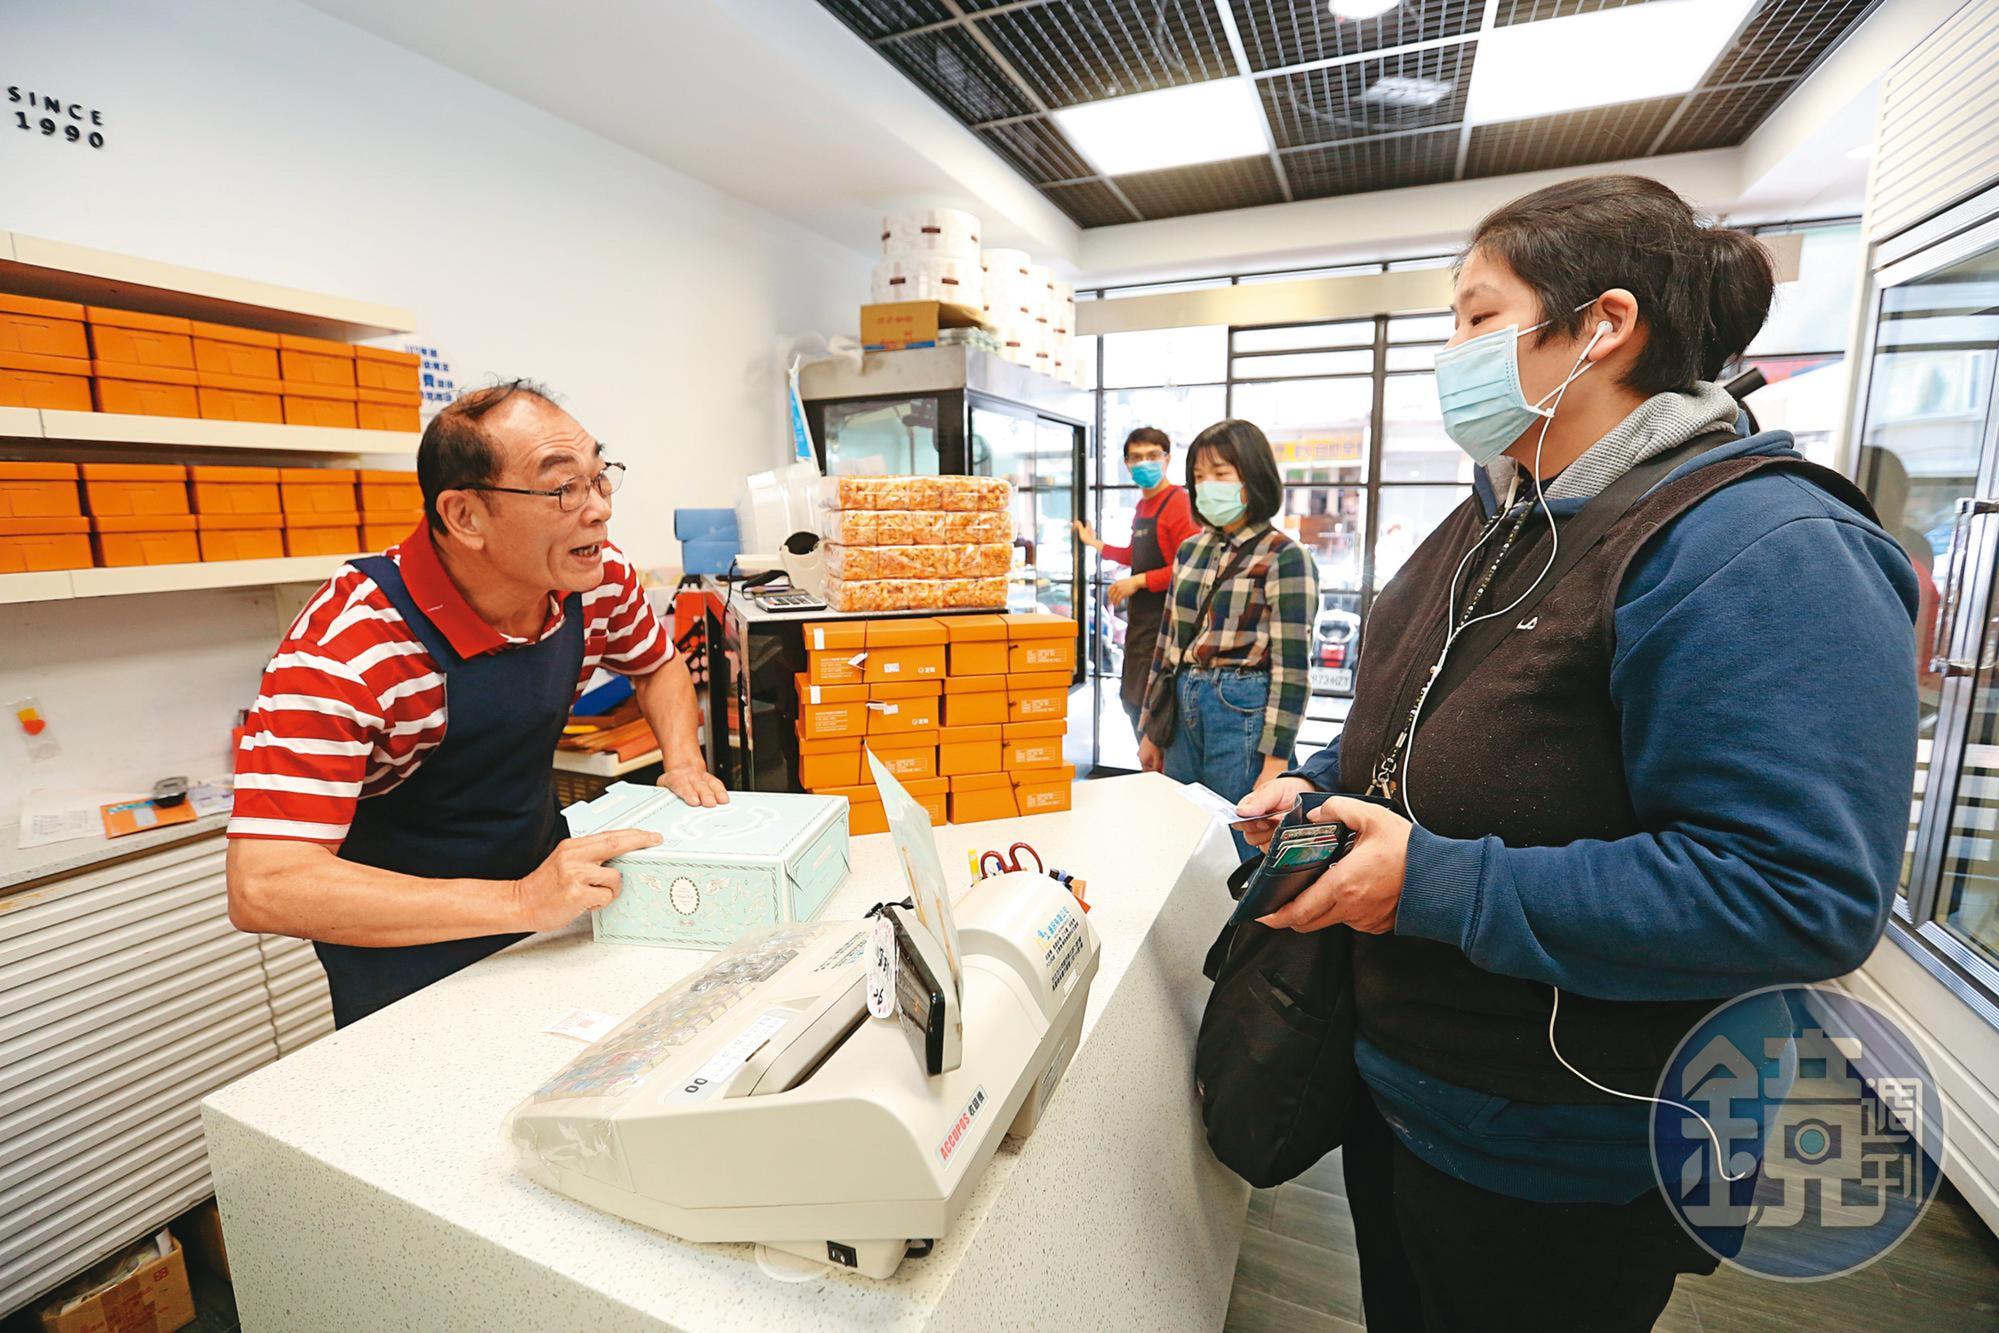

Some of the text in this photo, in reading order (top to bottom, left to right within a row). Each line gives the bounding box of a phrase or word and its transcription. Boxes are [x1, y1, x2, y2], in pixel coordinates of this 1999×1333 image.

[7, 85, 103, 126] SINCE
[15, 111, 104, 148] 1990
[940, 1112, 970, 1161] ACCUPOS
